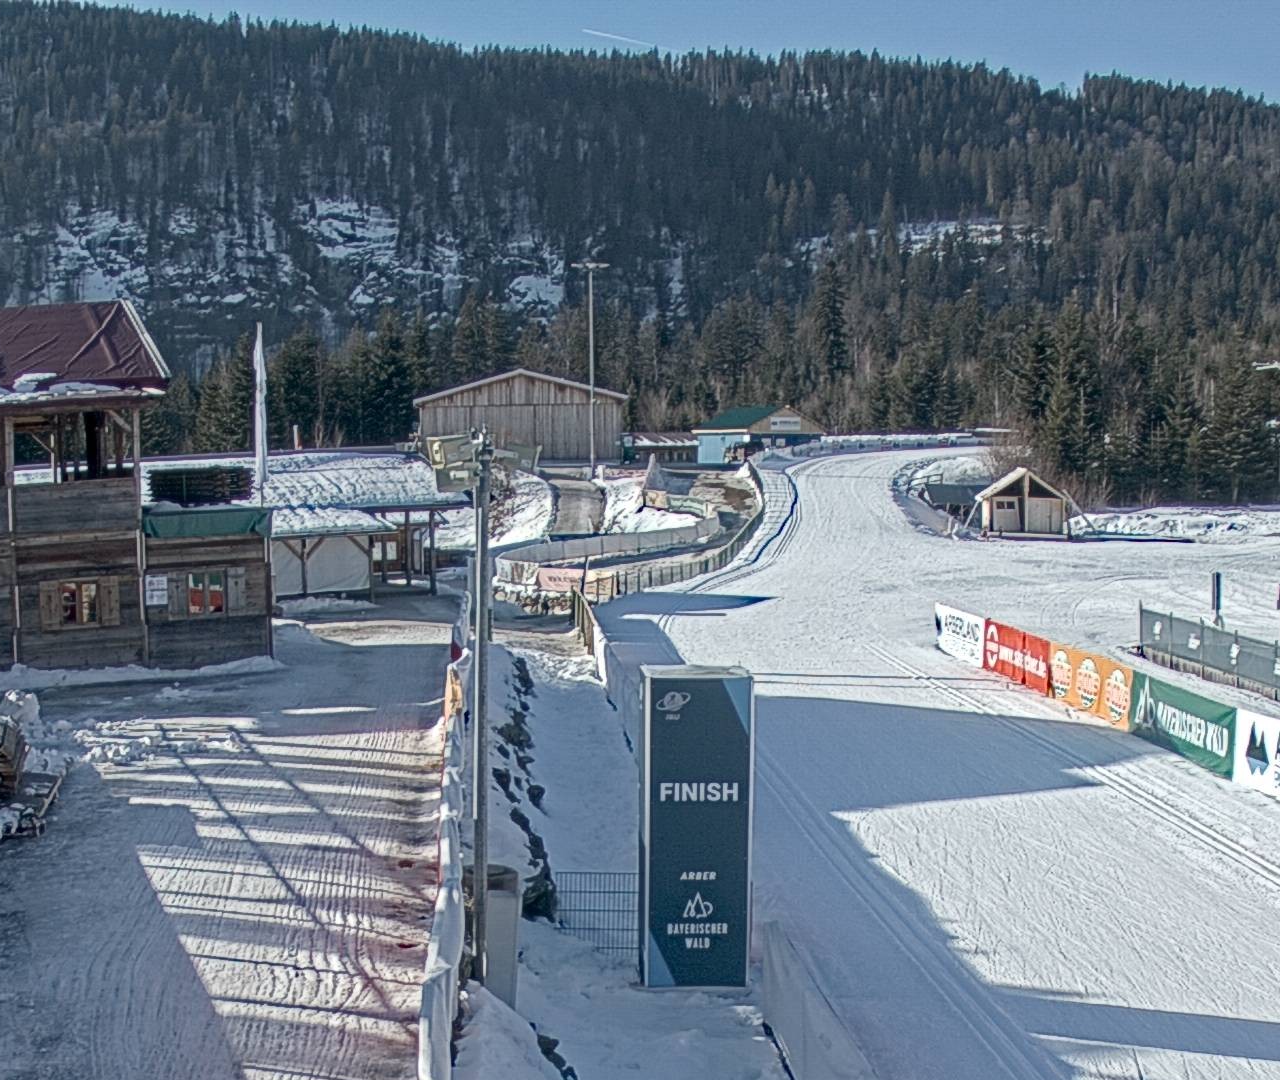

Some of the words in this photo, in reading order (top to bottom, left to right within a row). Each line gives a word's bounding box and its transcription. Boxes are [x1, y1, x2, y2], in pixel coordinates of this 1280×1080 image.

[659, 782, 739, 802] FINISH
[667, 923, 728, 935] BAYERISCHER
[685, 938, 710, 949] WALD
